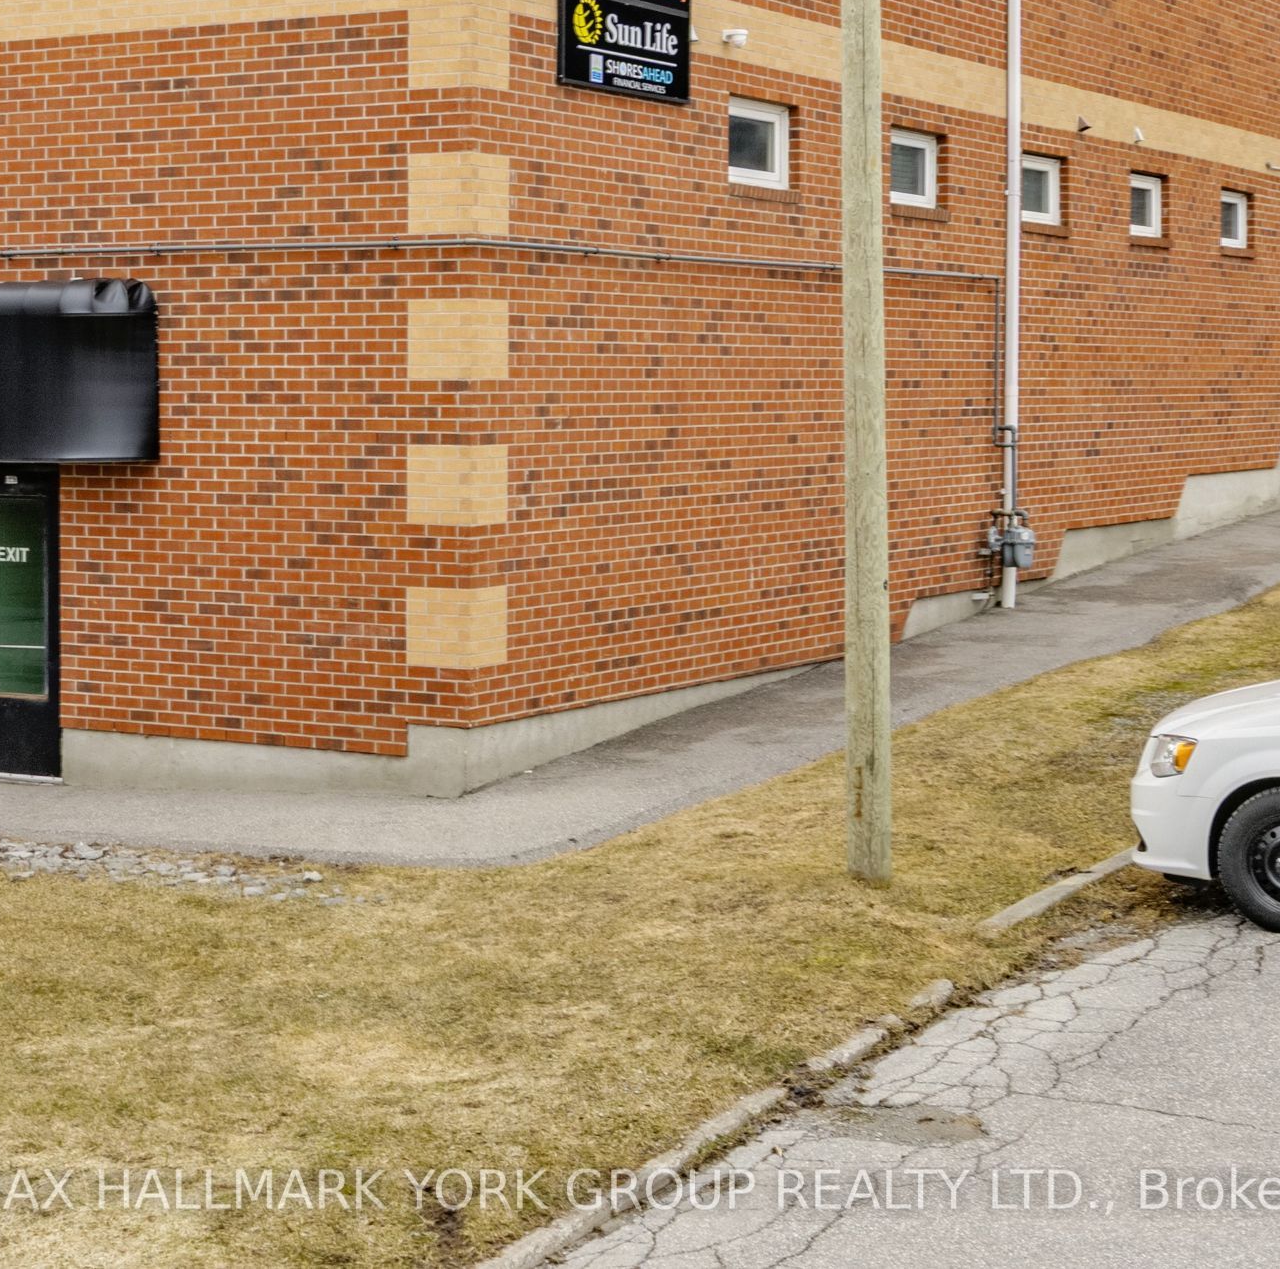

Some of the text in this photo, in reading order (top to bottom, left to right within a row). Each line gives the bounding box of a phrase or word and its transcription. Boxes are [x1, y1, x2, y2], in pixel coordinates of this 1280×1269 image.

[604, 13, 679, 56] Sun Life
[605, 59, 674, 85] SHORESAHEAD
